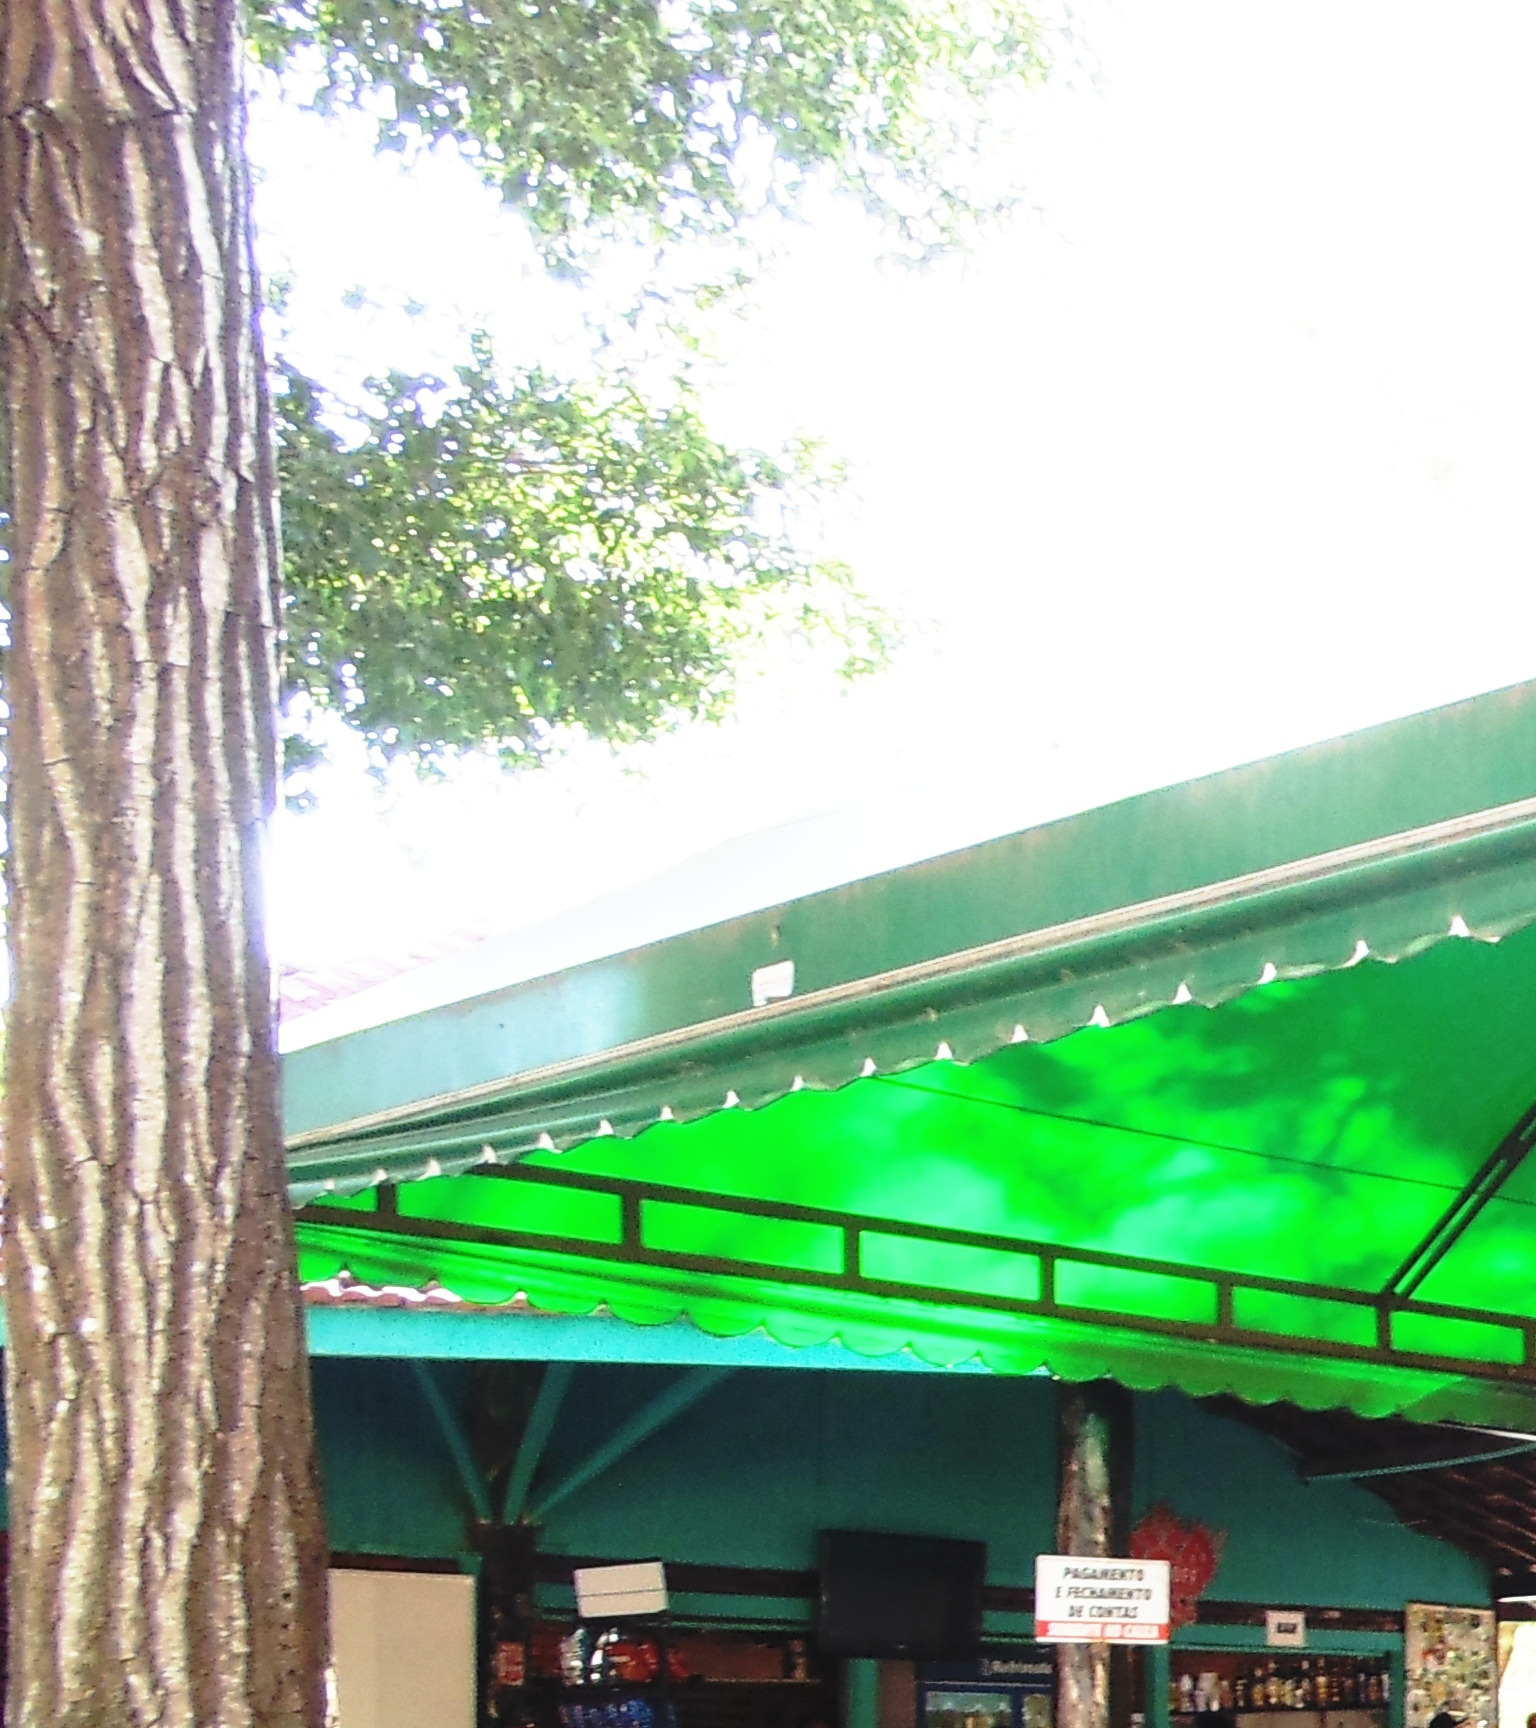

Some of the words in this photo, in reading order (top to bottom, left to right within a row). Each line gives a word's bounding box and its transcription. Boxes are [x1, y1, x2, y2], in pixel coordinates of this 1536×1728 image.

[1063, 1567, 1144, 1581] PAGAMENTO
[1055, 1586, 1063, 1598] E
[1066, 1586, 1153, 1600] FECHAMENTO
[1068, 1605, 1083, 1618] DE
[1089, 1606, 1139, 1618] CONTAS
